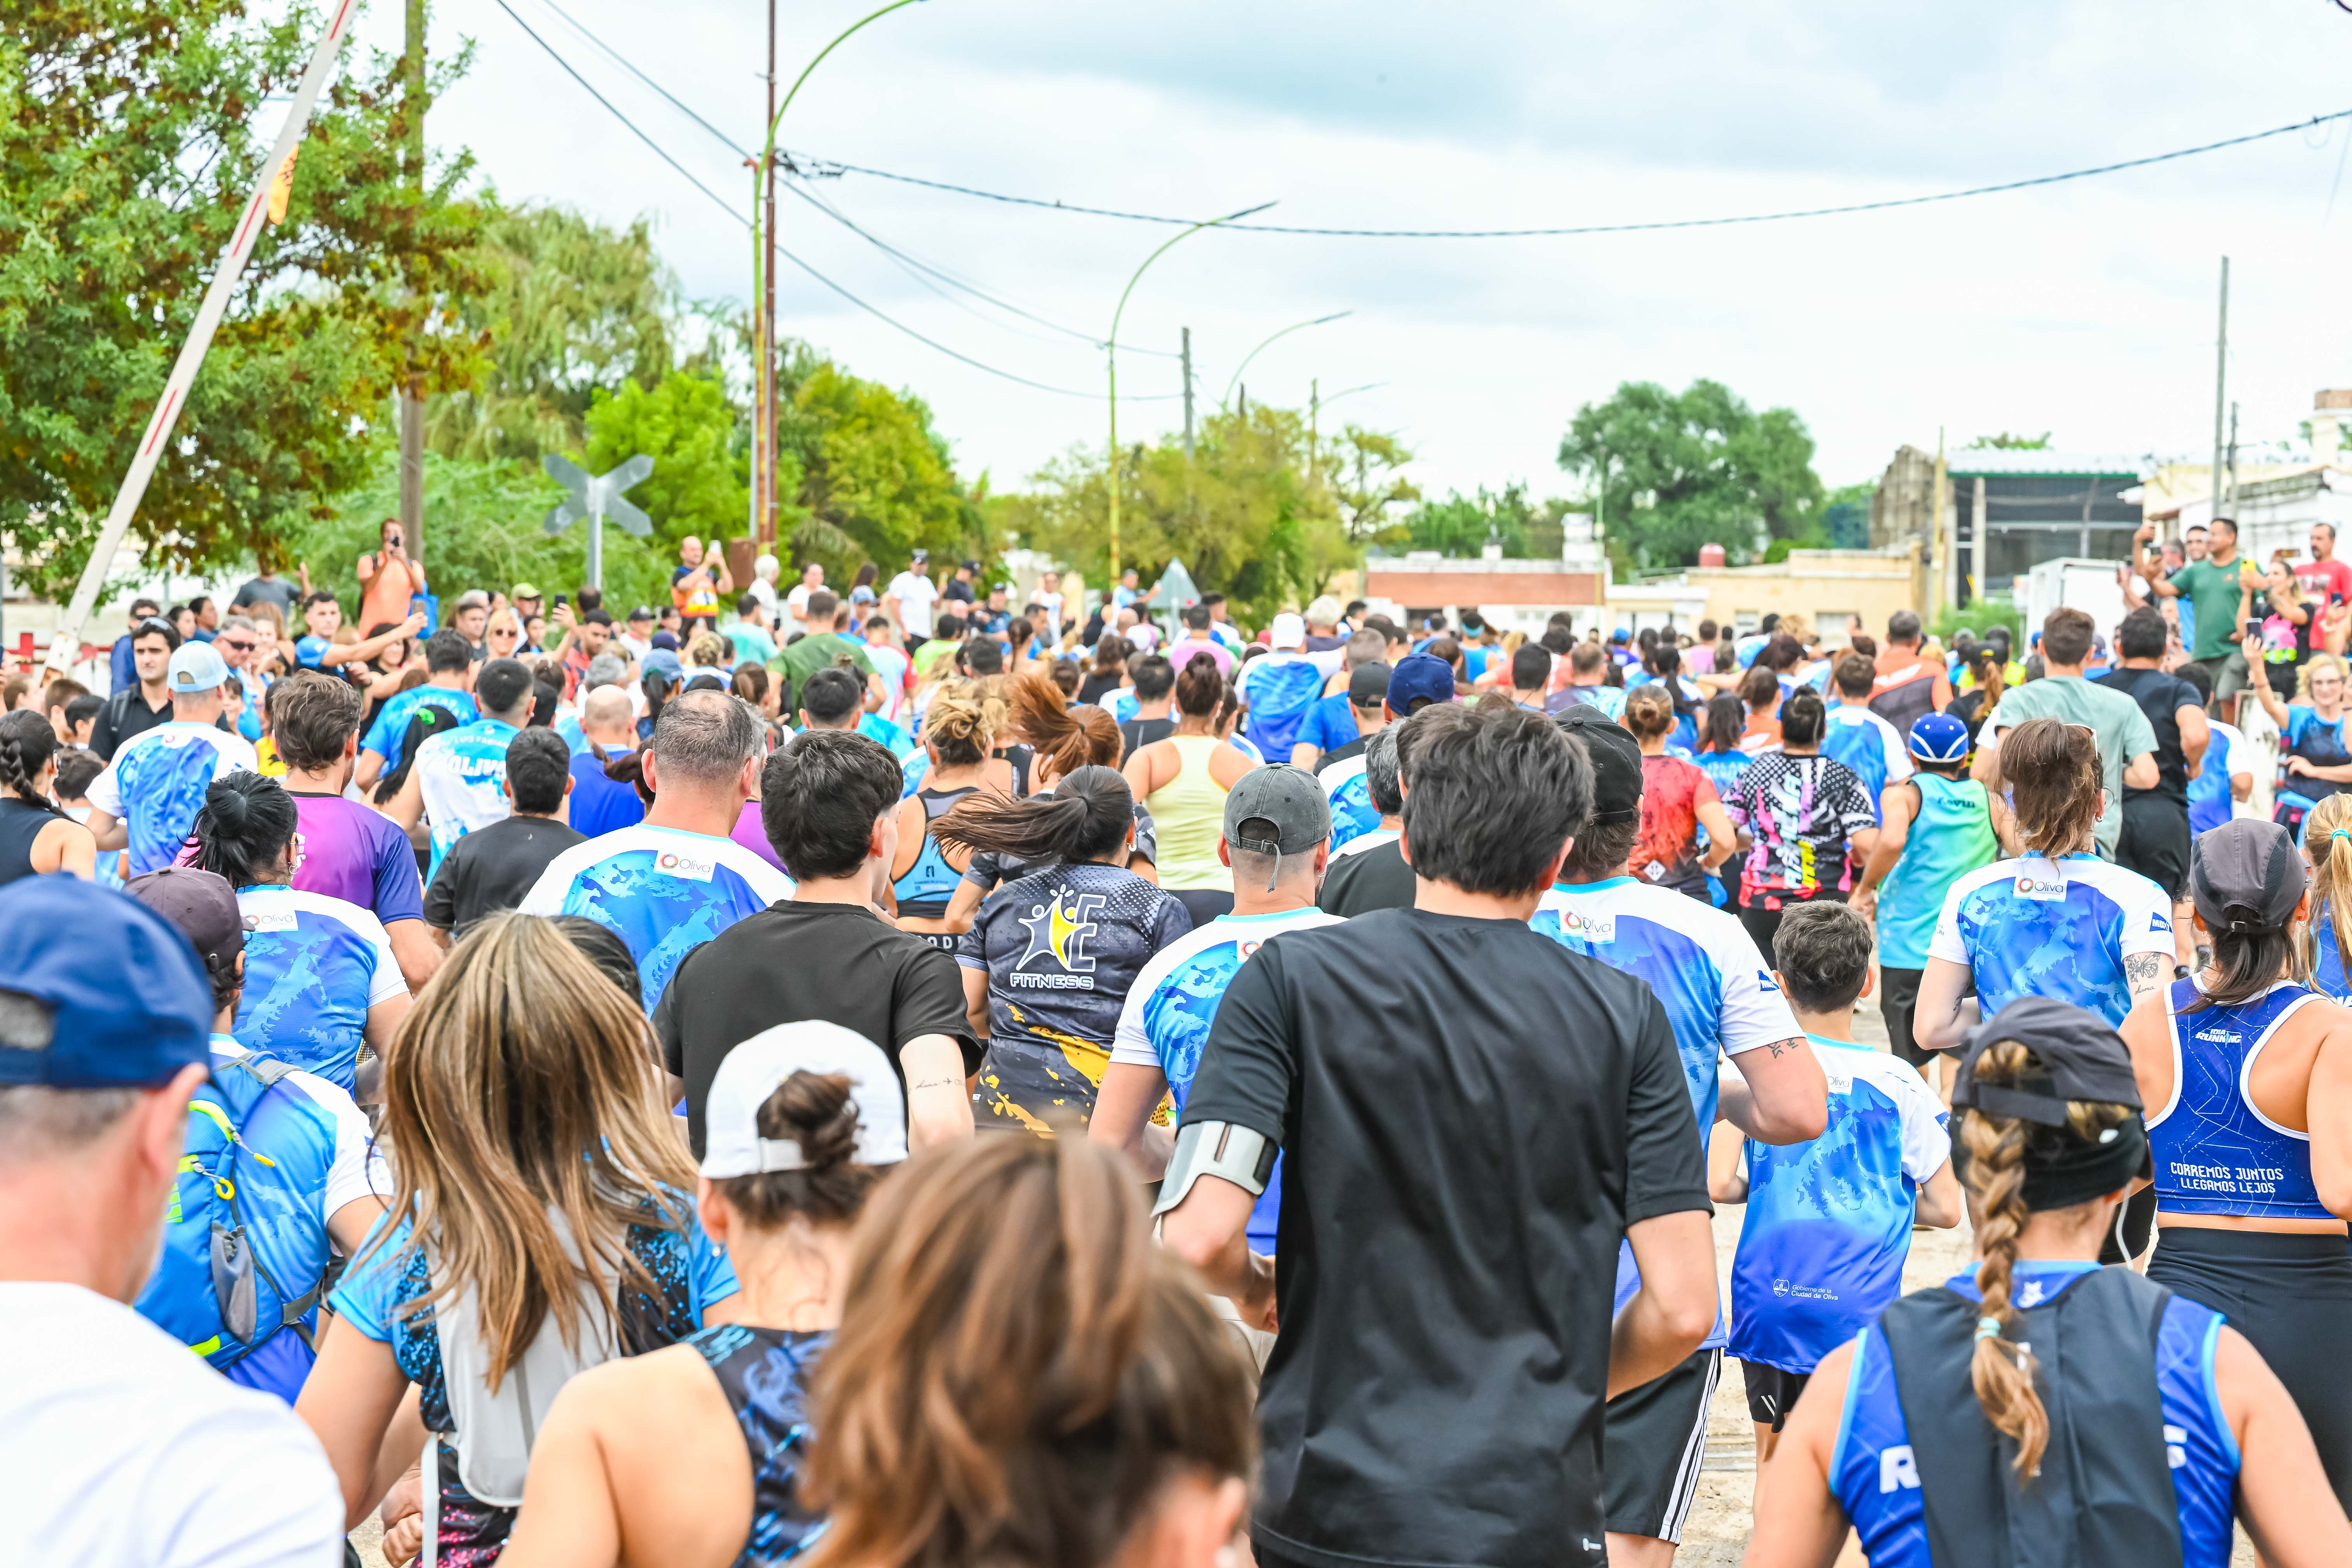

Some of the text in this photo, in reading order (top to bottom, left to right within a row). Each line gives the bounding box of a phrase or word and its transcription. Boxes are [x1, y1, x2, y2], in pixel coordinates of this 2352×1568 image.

[679, 859, 710, 873] Oliva
[2034, 881, 2063, 892] Oliva
[261, 914, 292, 924] Oliva
[1010, 972, 1094, 990] FITNESS
[2195, 1032, 2242, 1043] RUNNING
[2170, 1162, 2284, 1180] CORREMOS JUNTOS
[2180, 1178, 2276, 1193] LLEGAMOS LEJOS
